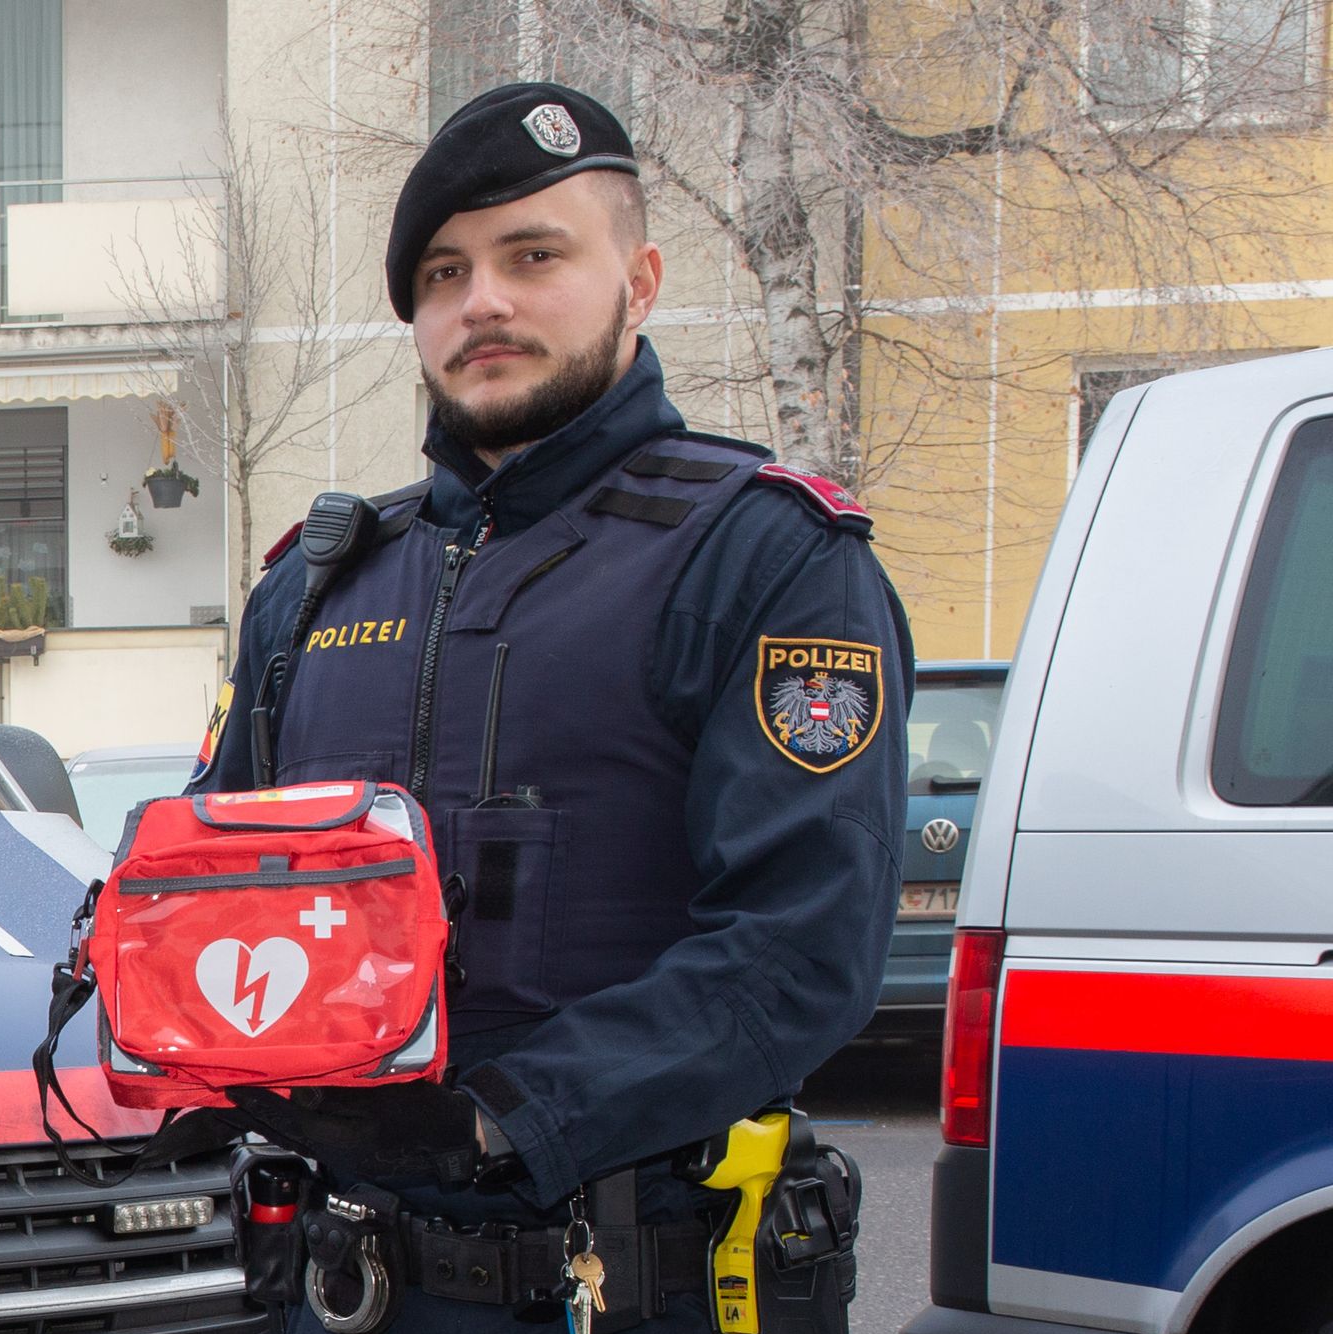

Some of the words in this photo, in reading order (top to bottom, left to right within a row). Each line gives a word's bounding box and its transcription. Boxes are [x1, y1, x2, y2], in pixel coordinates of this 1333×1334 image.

[473, 527, 489, 549] POLI
[306, 618, 406, 653] POLIZEI
[768, 647, 873, 673] POLIZEI
